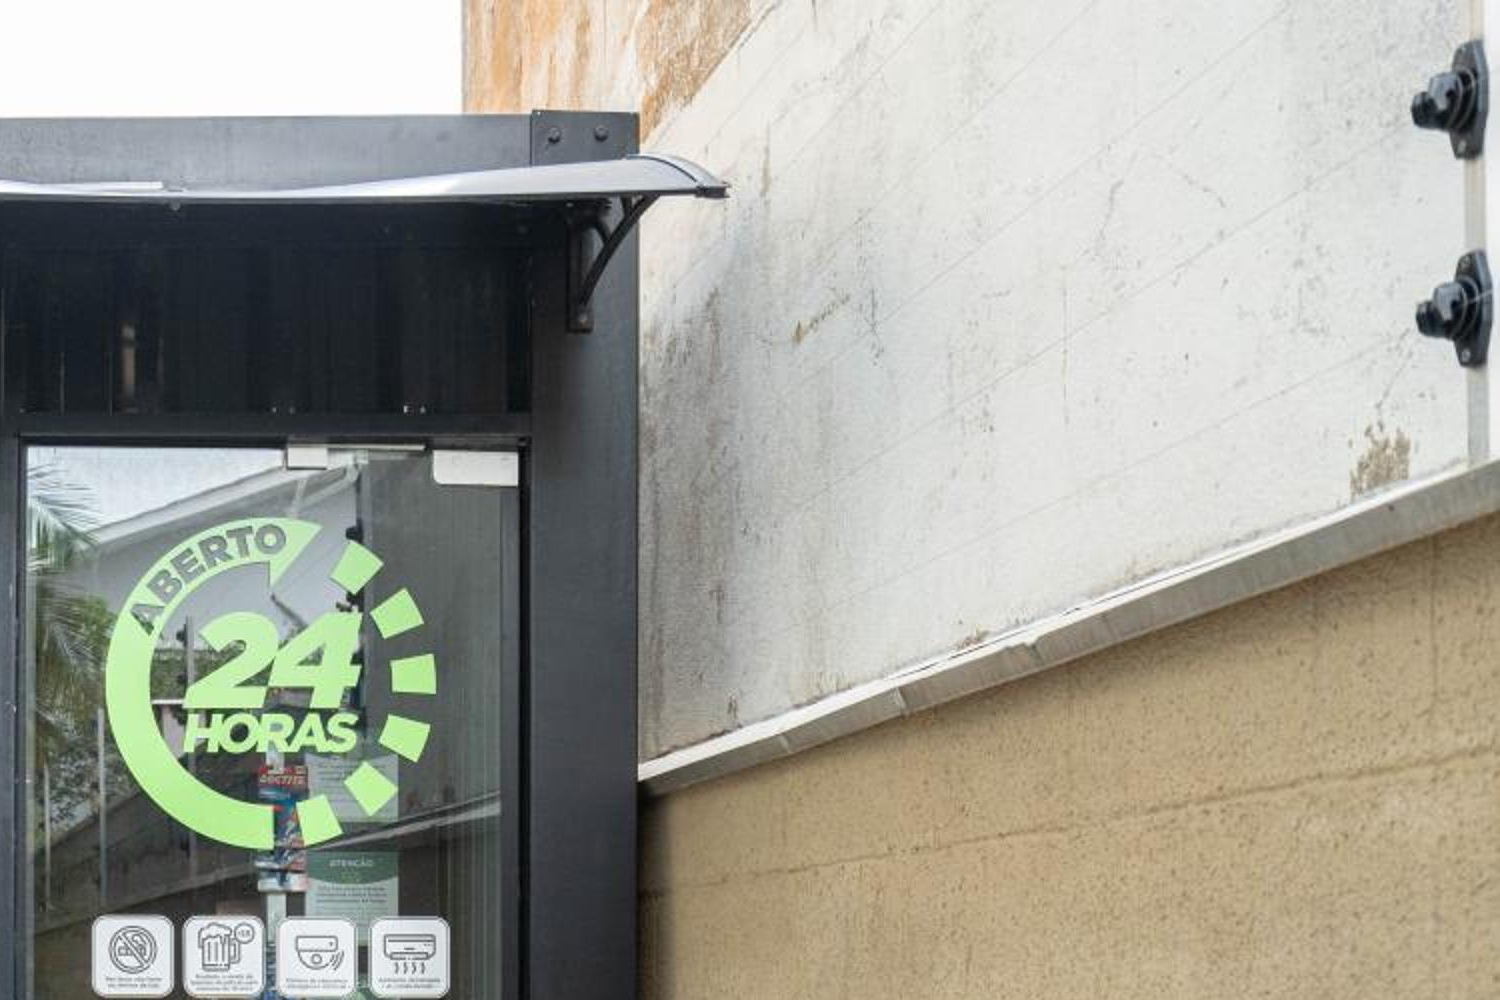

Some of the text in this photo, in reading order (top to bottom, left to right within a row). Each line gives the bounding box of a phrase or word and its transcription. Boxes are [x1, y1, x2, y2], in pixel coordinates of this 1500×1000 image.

[129, 523, 287, 638] ABERTO
[183, 611, 363, 709] 24
[183, 713, 359, 754] HORAS
